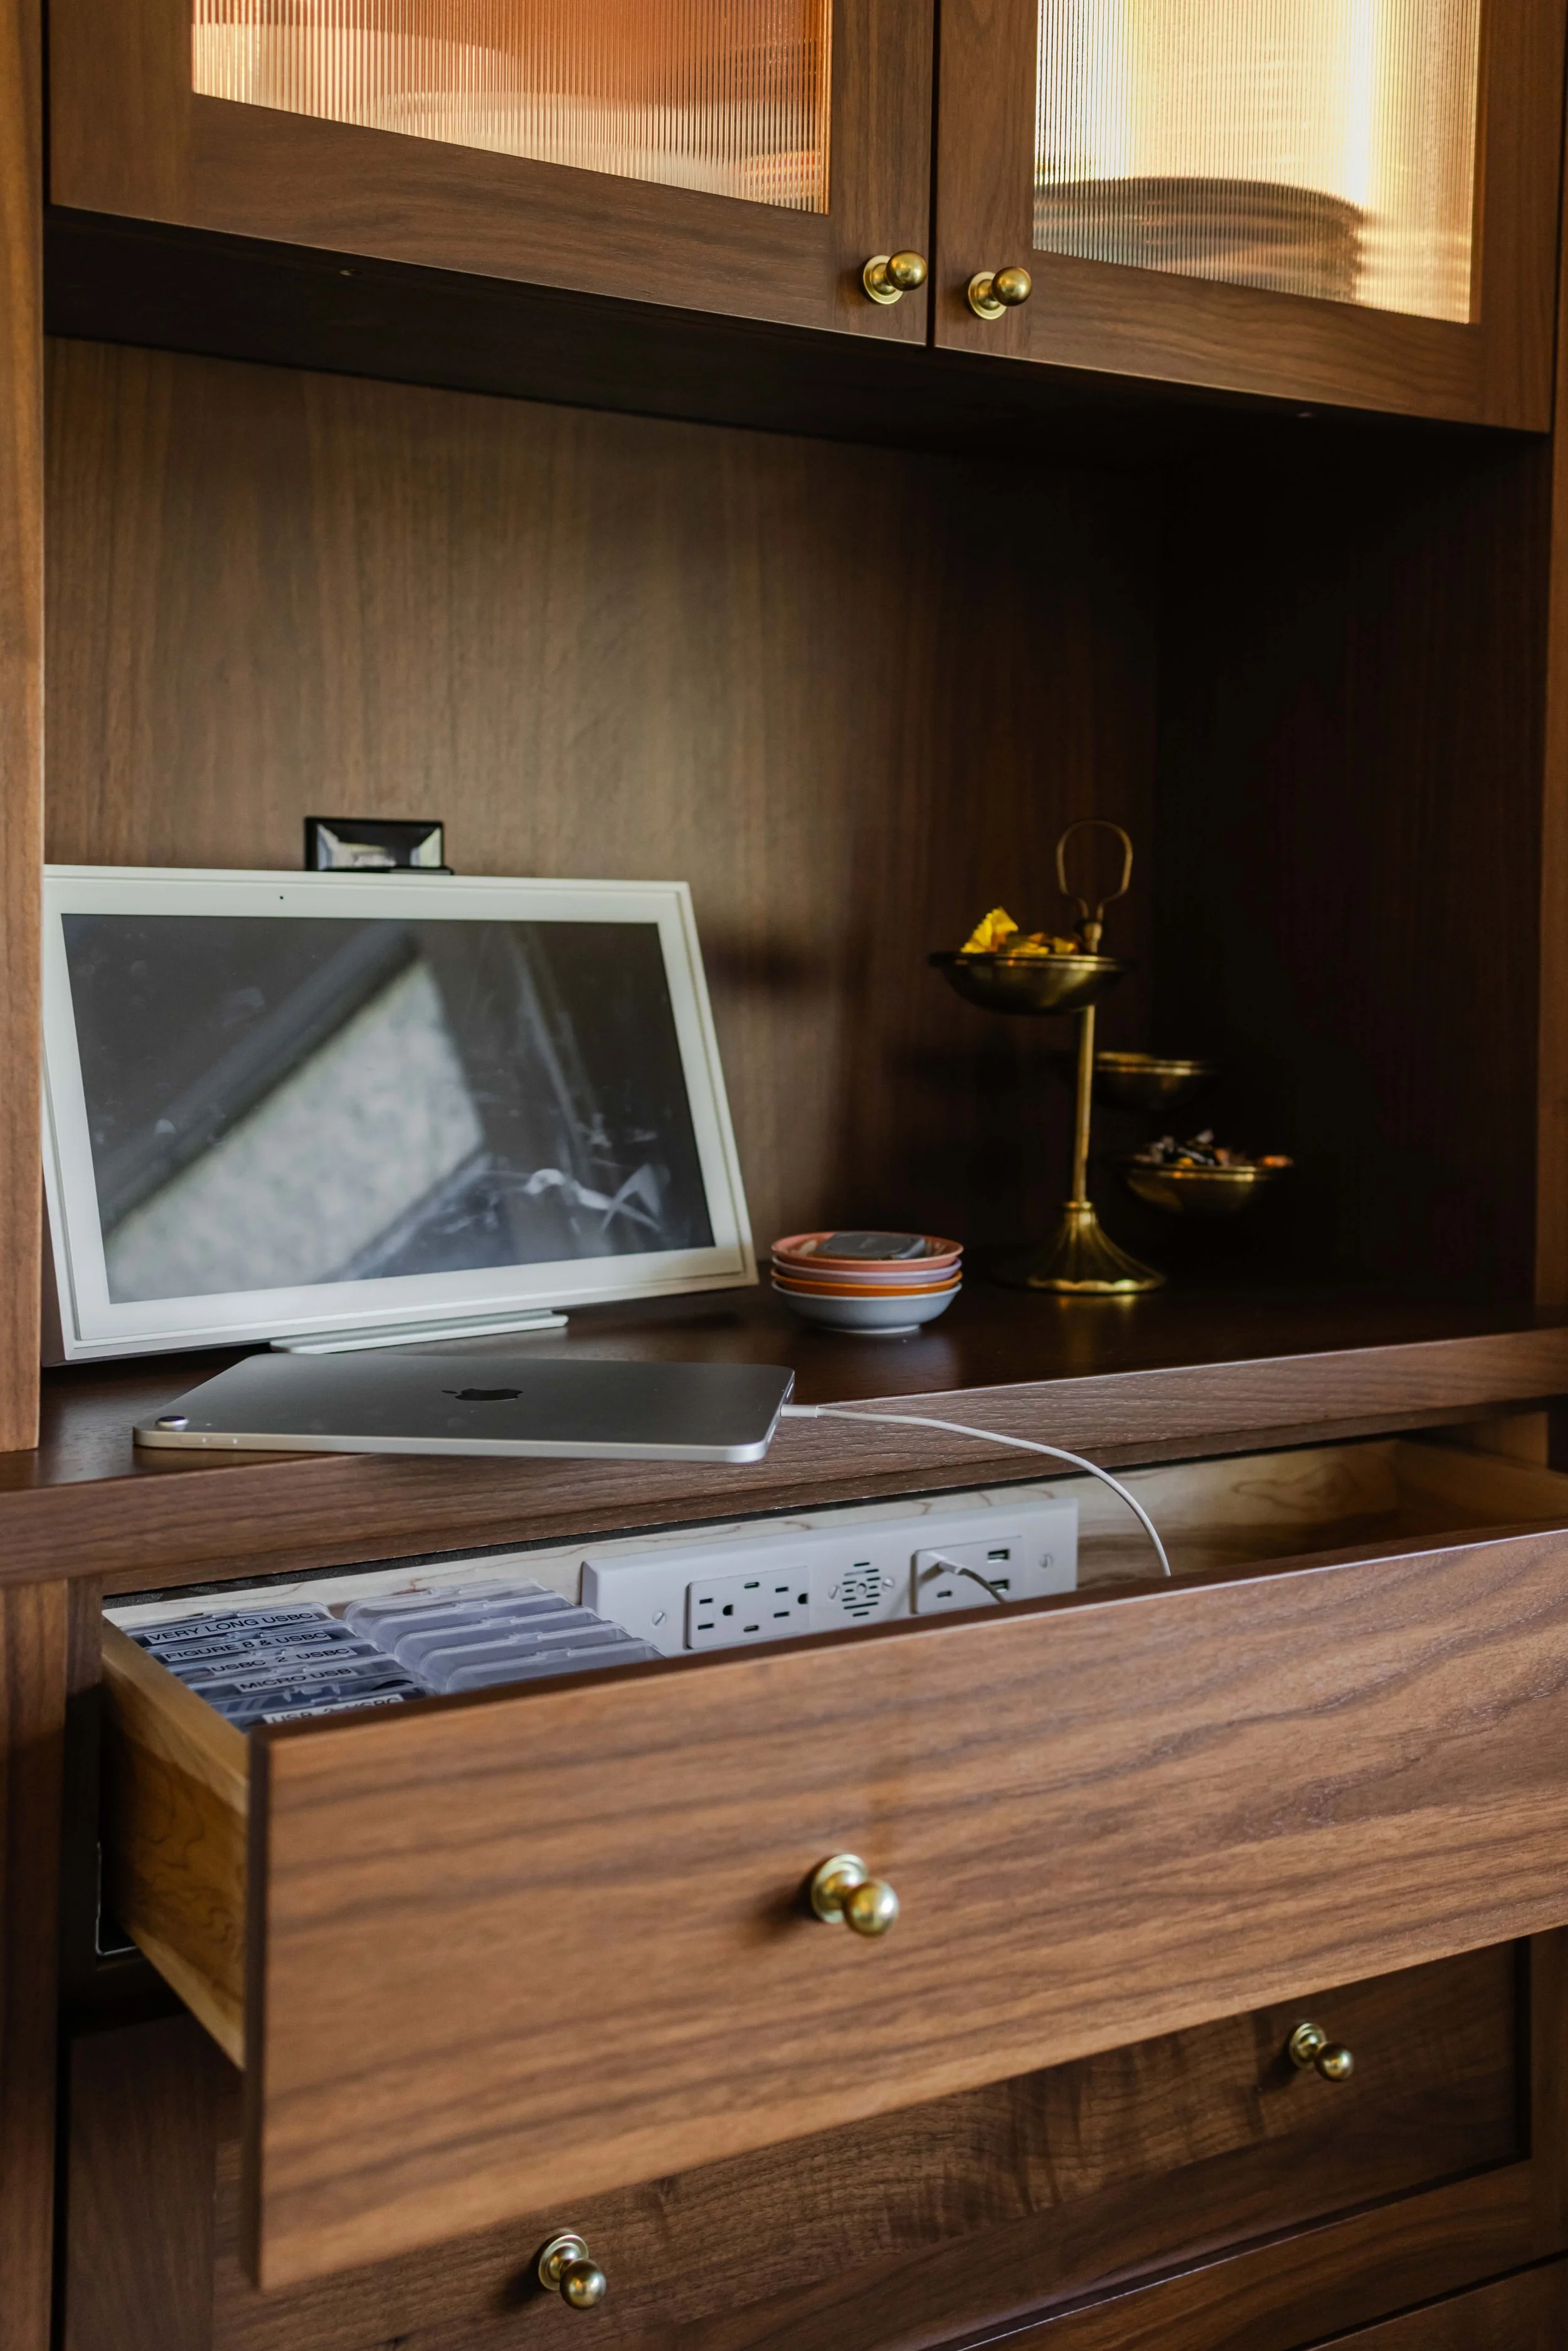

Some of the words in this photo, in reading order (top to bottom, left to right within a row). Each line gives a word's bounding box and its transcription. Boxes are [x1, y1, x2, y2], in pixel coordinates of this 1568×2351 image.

[148, 1628, 199, 1641] VERY
[205, 1619, 259, 1632] LONG
[262, 1613, 313, 1623] USBC
[165, 1644, 239, 1660] FIGURE
[275, 1632, 327, 1643] USBC
[211, 1660, 266, 1672] USBC
[296, 1648, 349, 1659] USBC
[239, 1675, 307, 1689] MICRO
[310, 1669, 351, 1679] USB
